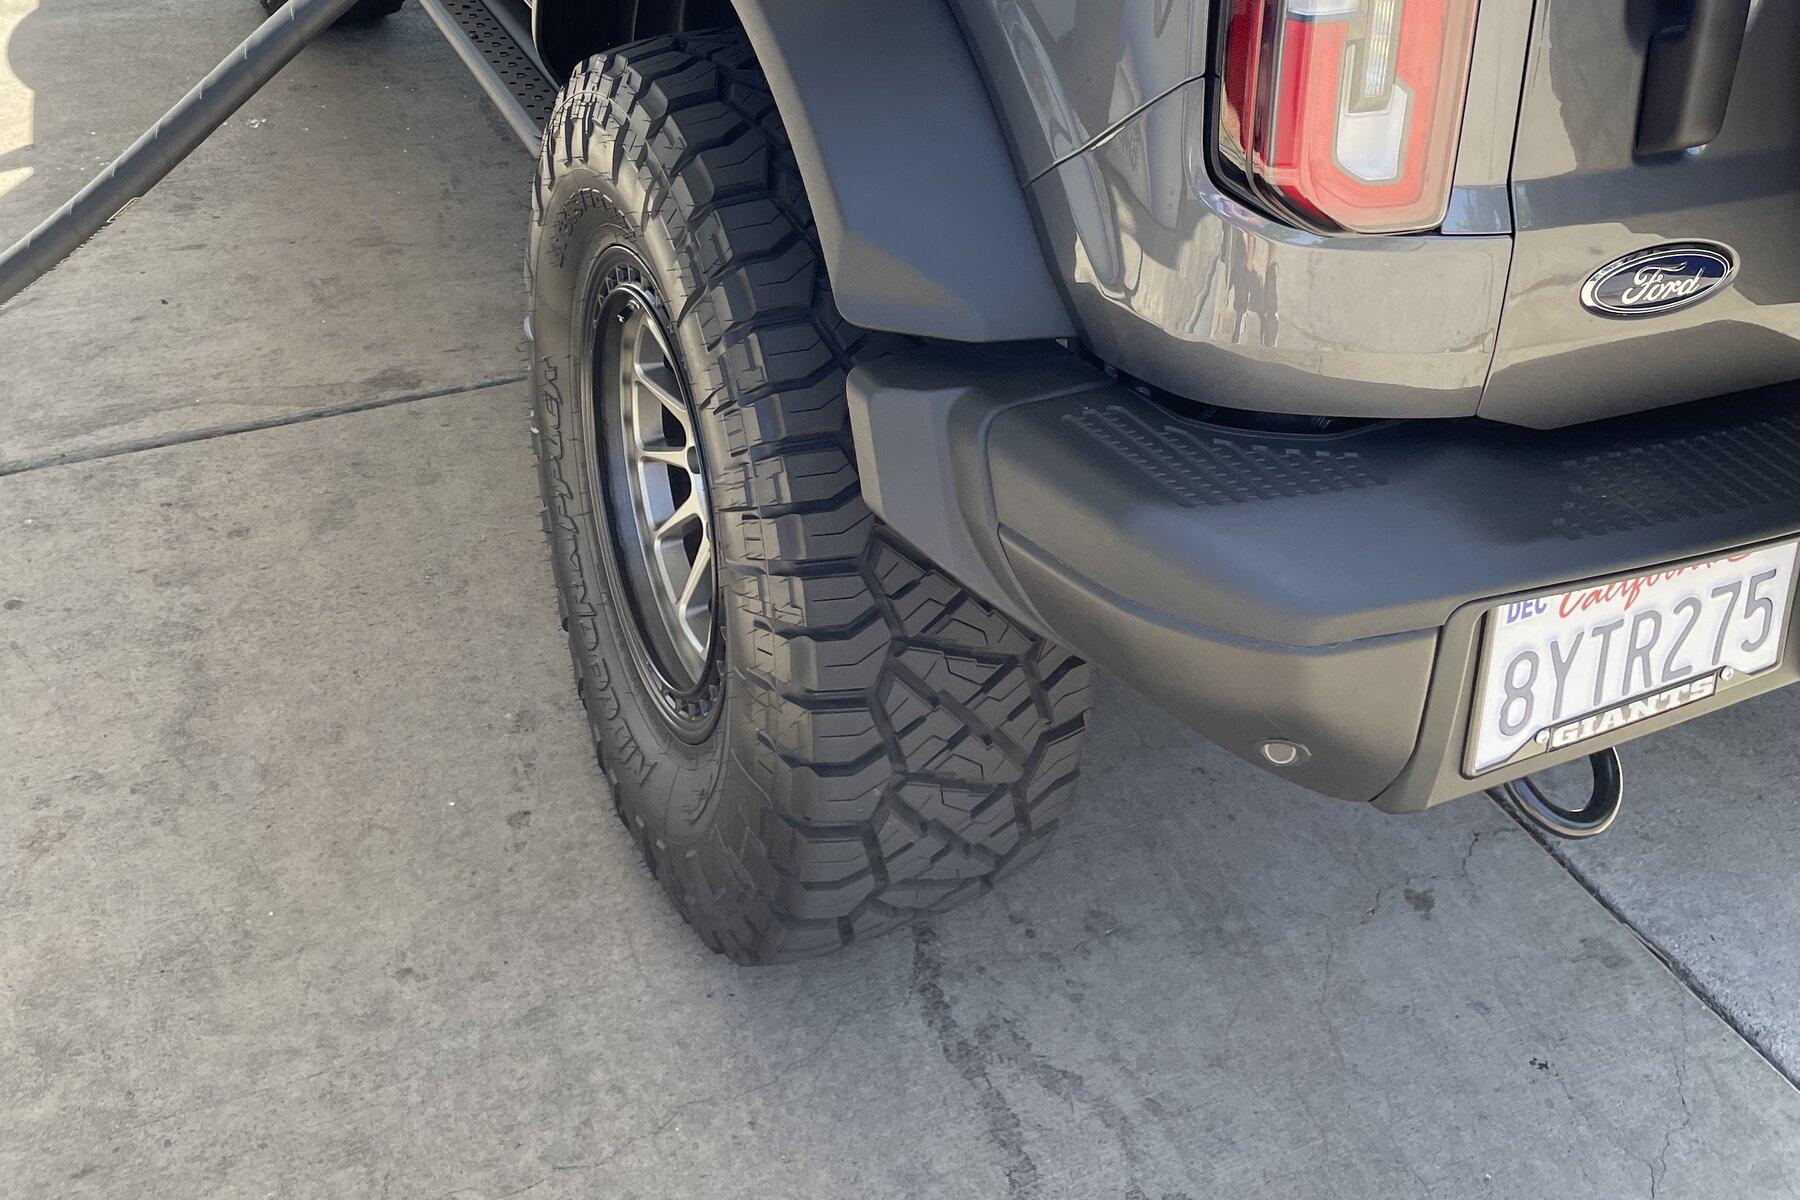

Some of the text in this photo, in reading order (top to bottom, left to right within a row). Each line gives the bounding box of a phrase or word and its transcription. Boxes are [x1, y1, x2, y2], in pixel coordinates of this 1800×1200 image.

[1621, 261, 1706, 304] Ford
[1507, 598, 1547, 623] DEC
[1498, 568, 1777, 737] 8YTR275
[1552, 672, 1714, 747] GIANTS
